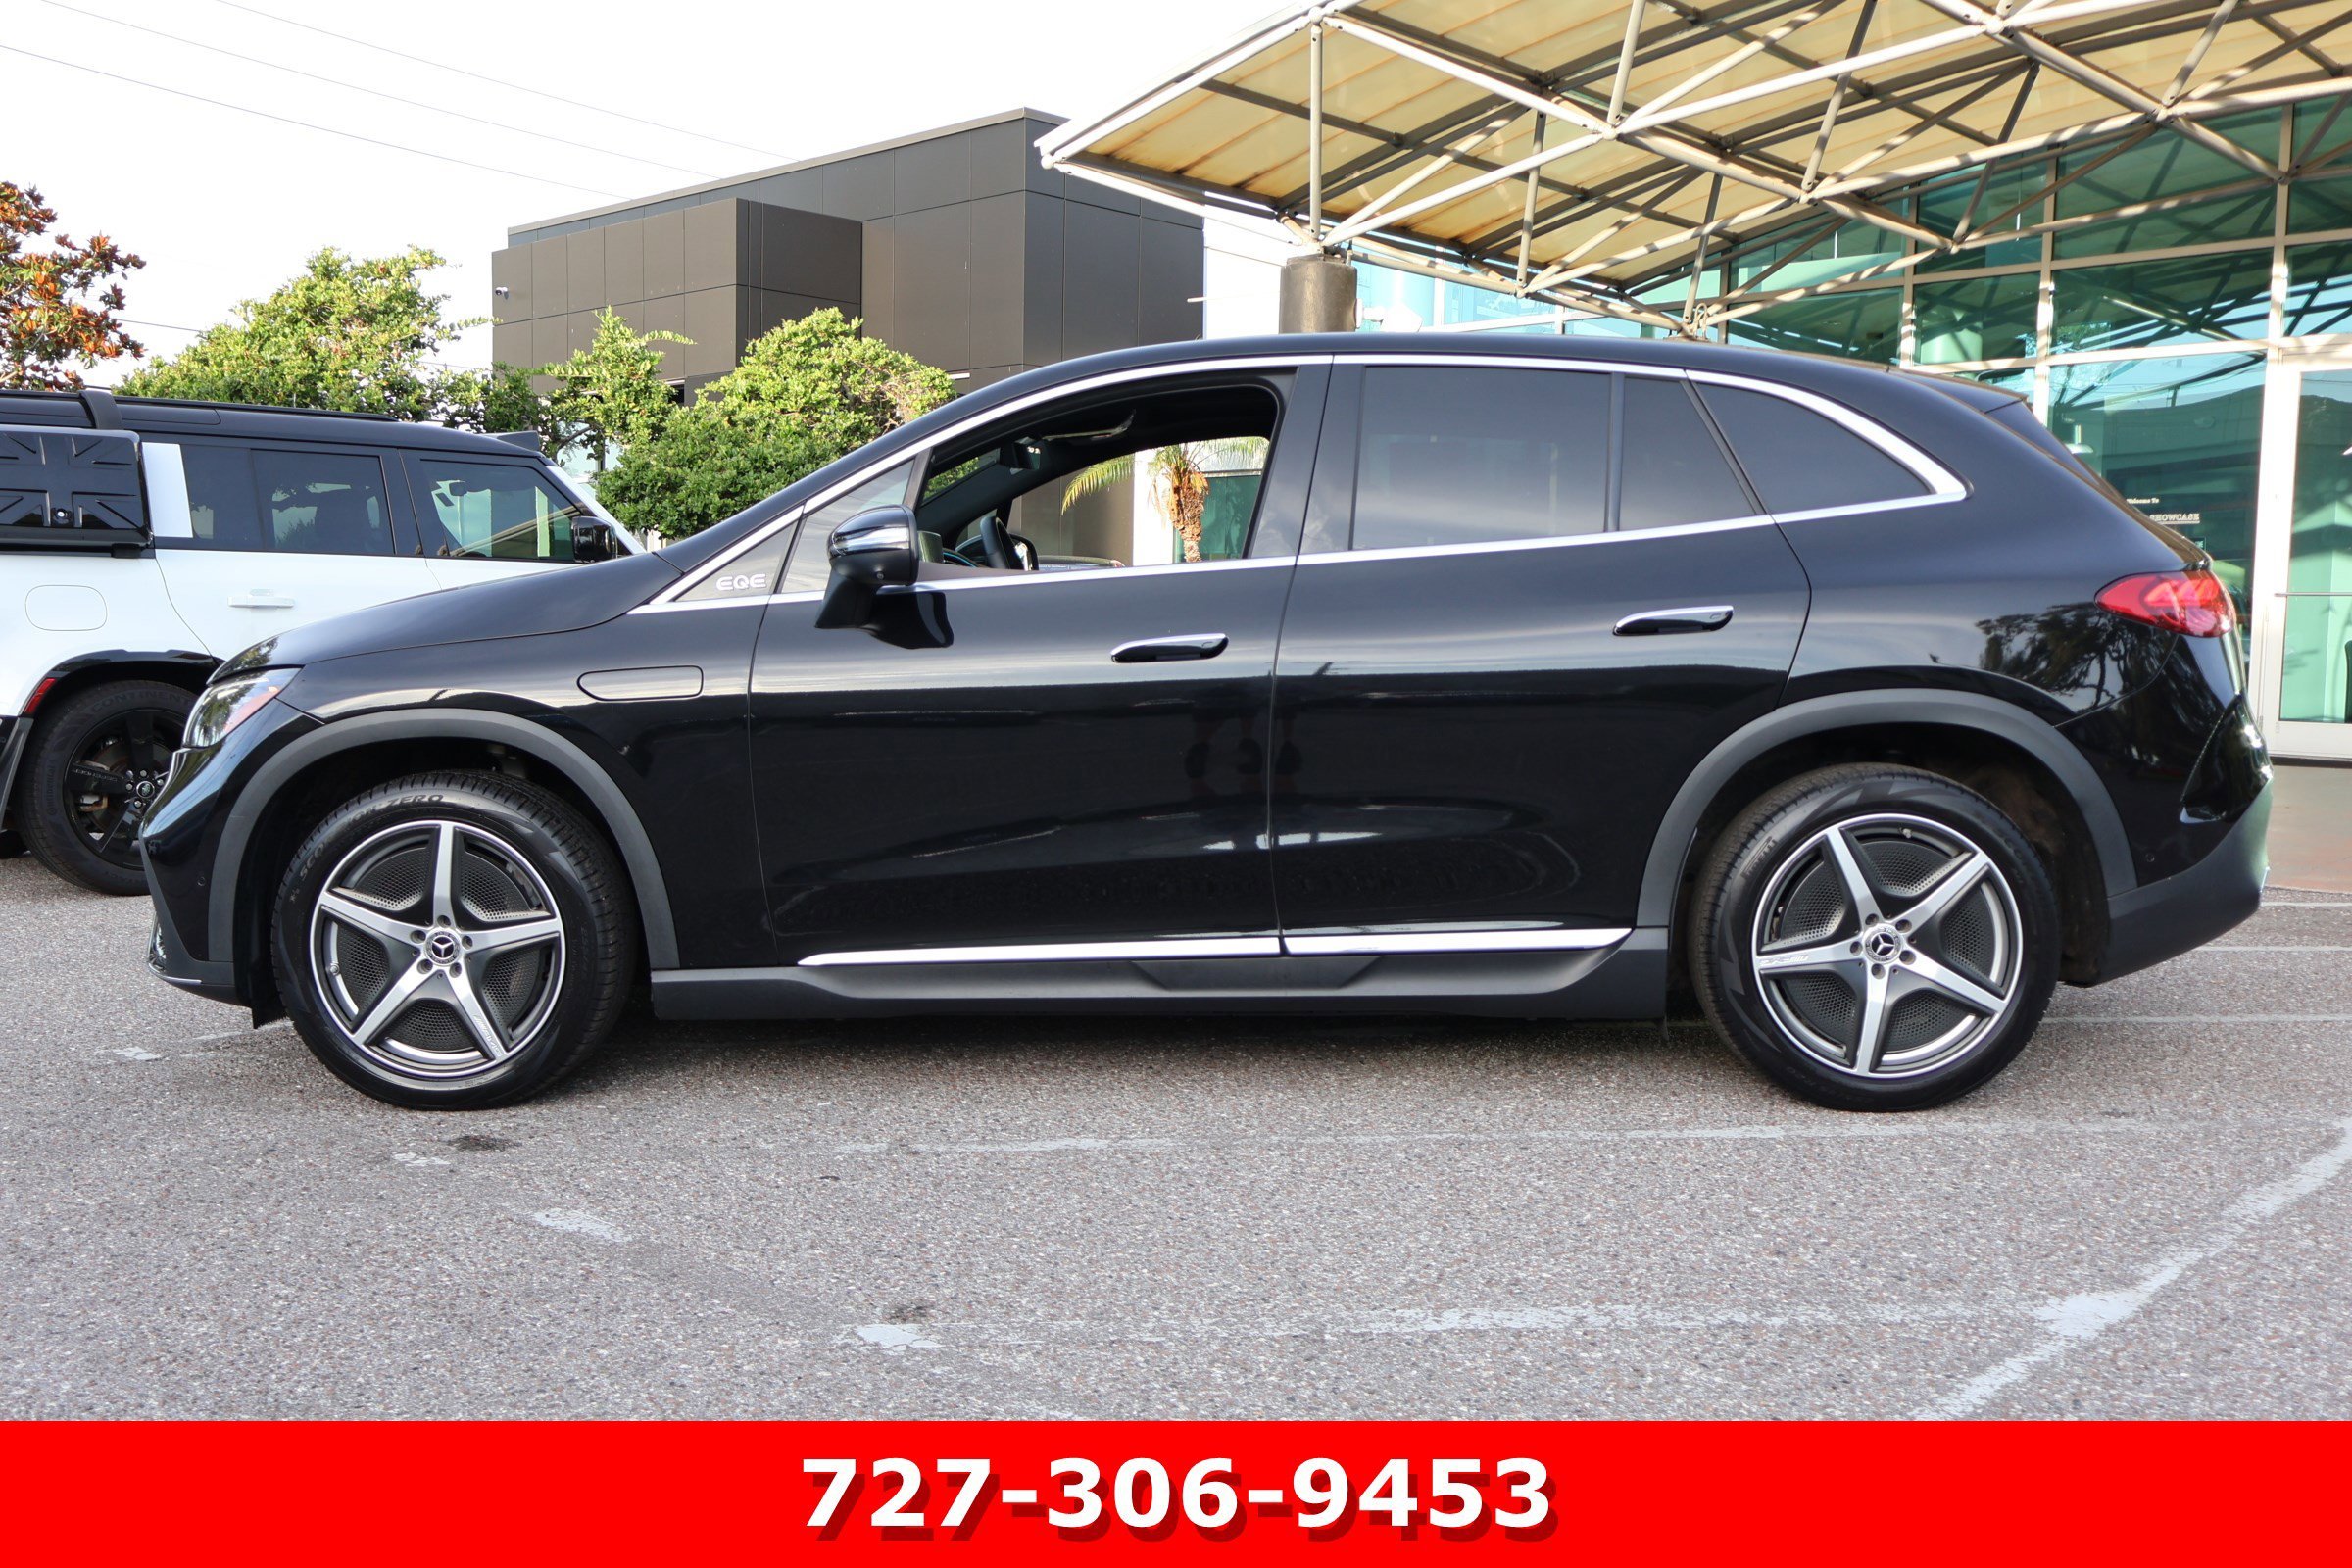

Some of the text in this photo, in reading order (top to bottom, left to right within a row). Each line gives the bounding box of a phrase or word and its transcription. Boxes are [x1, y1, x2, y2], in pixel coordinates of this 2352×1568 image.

[2149, 513, 2200, 521] SHOWCASE
[716, 573, 766, 591] EQE
[91, 689, 194, 713] CONTINENT
[387, 794, 445, 808] ZERO
